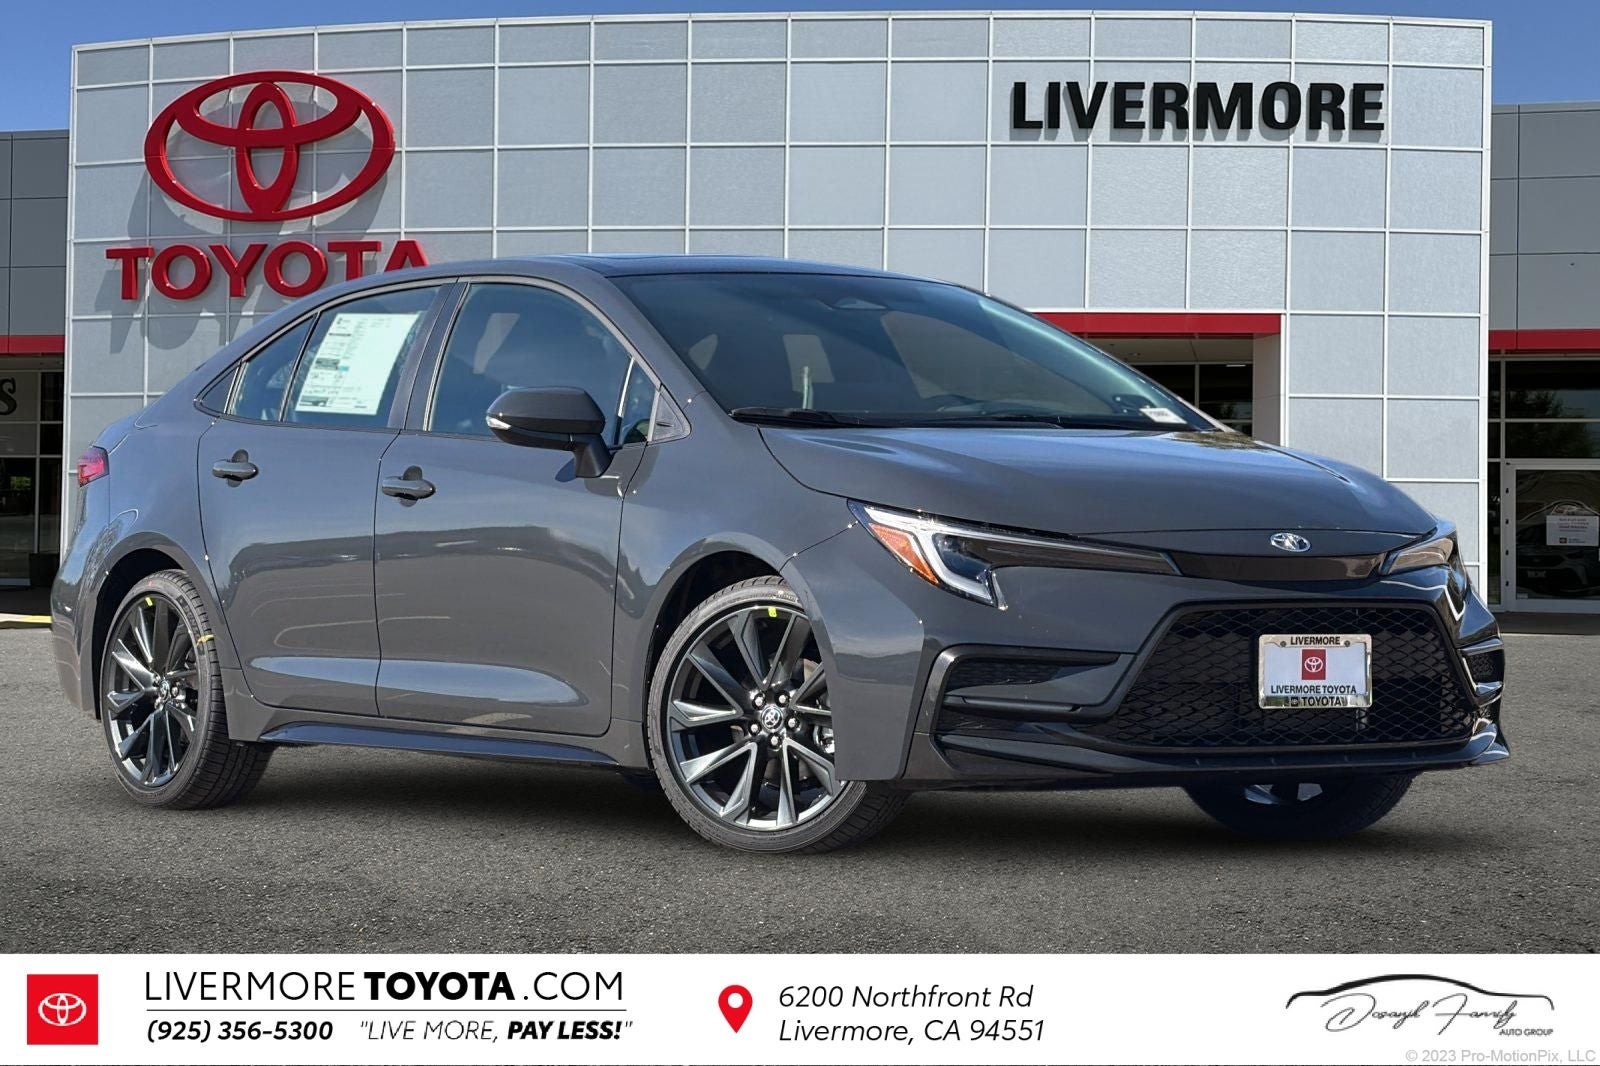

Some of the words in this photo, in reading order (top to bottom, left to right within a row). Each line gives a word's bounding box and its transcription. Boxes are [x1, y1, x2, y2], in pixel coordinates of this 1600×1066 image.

[1012, 81, 1385, 131] LIVERMORE
[1290, 636, 1341, 646] LIVERMORE
[1270, 685, 1321, 694] LIVERMORE
[1323, 685, 1357, 694] TOYOTA
[1302, 696, 1341, 706] TOYOTA
